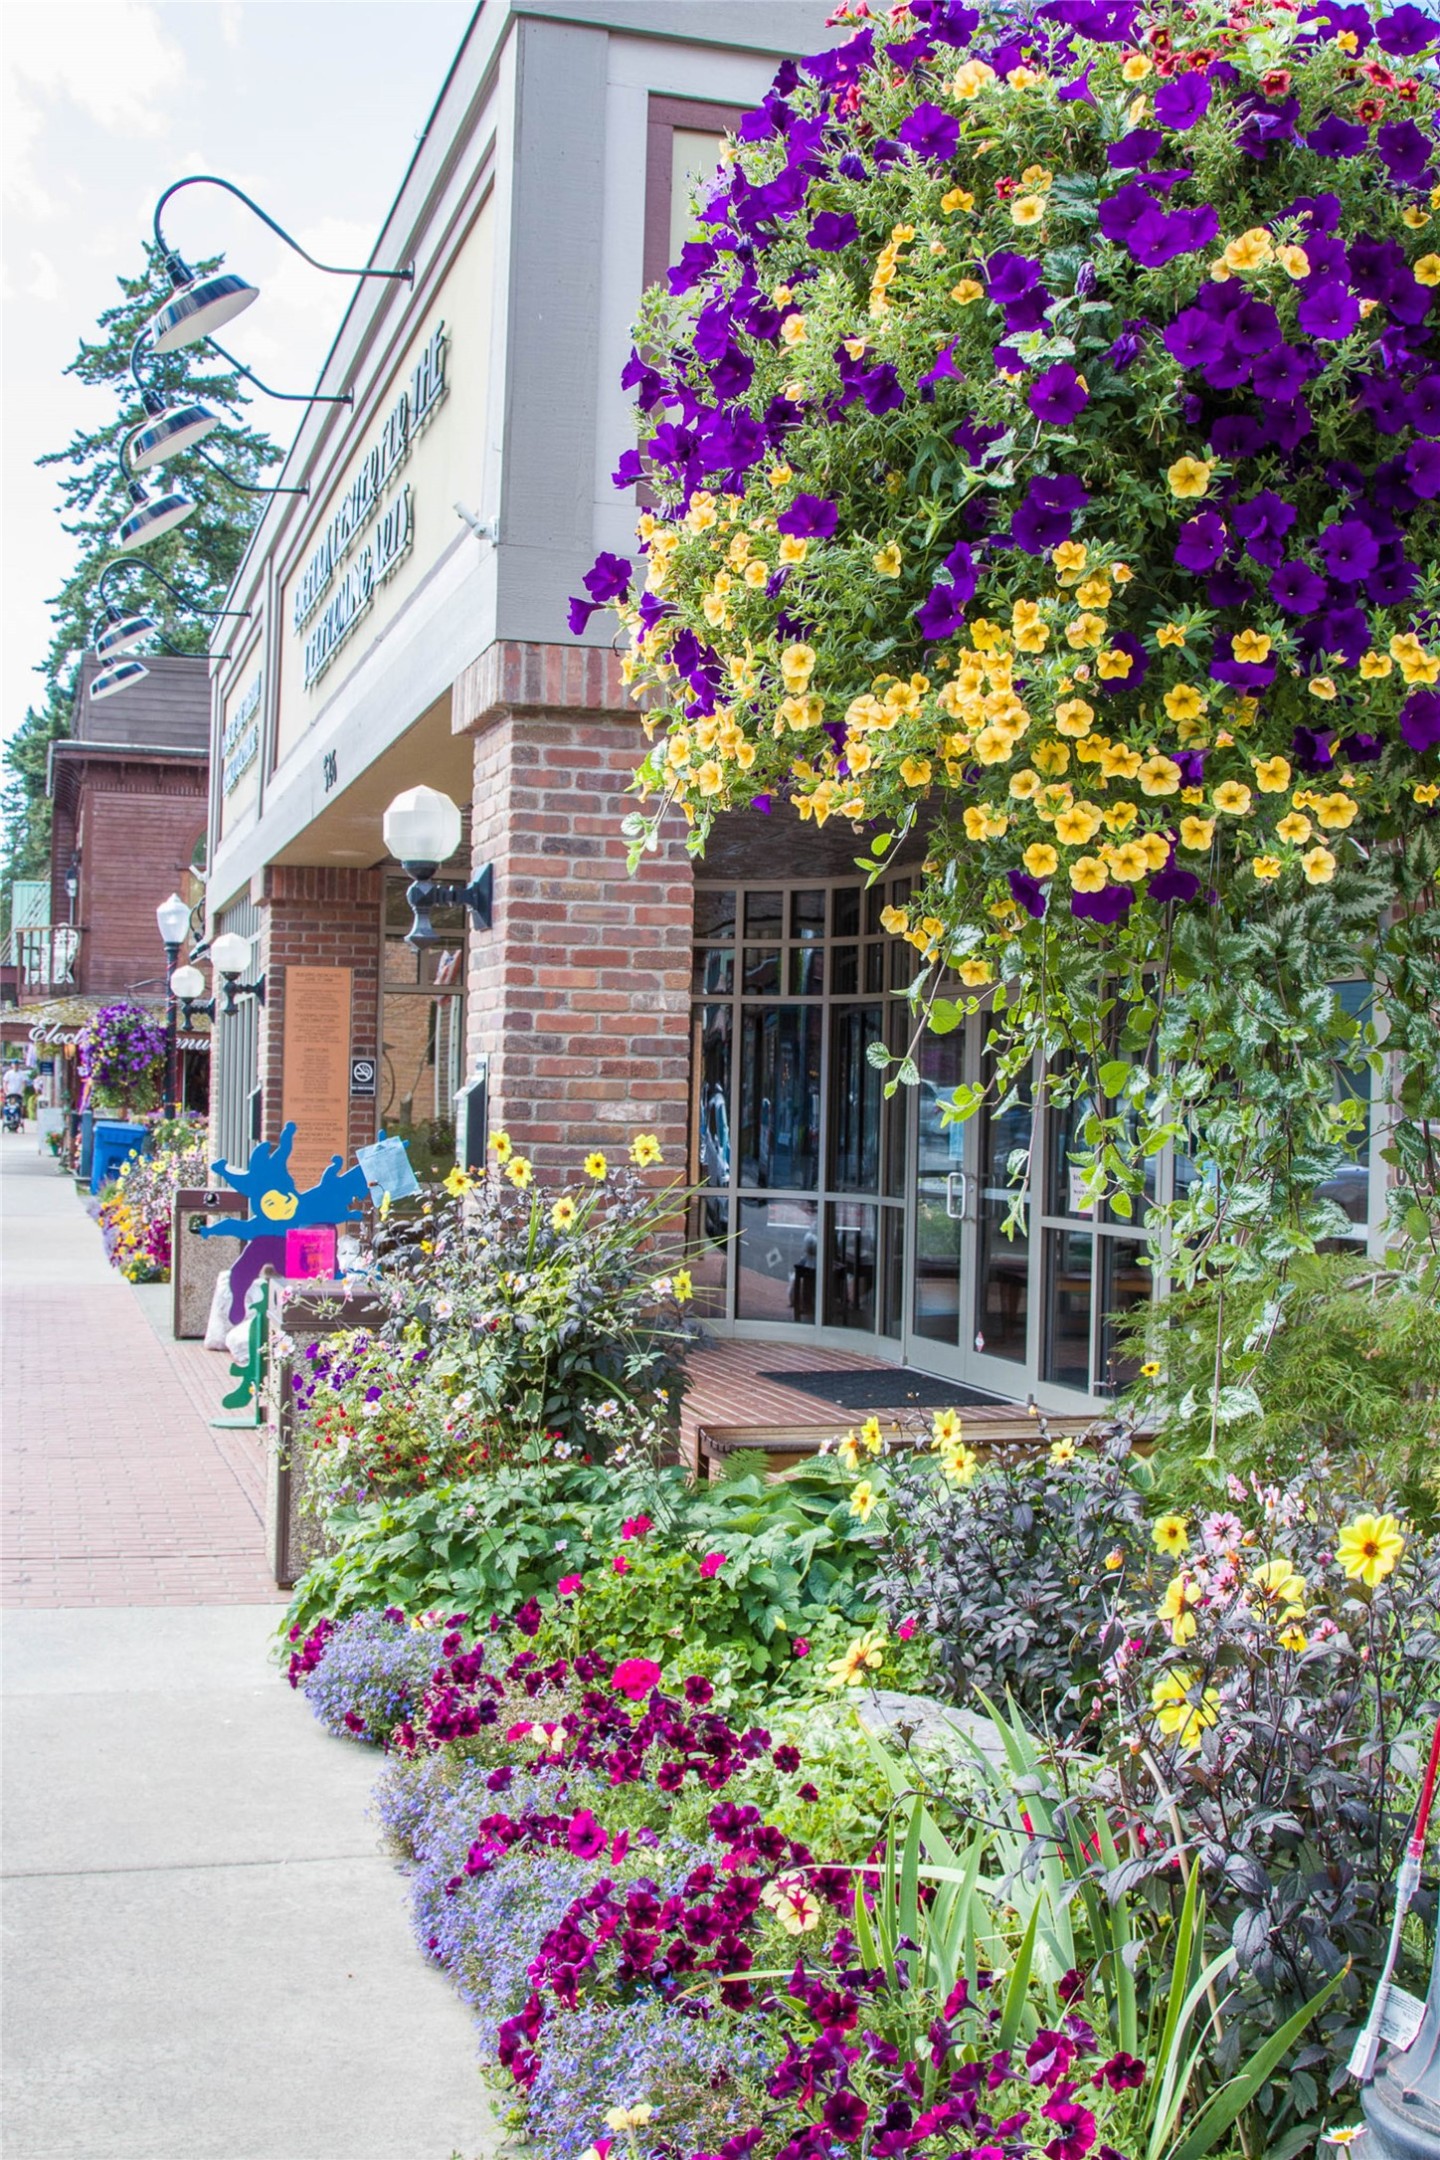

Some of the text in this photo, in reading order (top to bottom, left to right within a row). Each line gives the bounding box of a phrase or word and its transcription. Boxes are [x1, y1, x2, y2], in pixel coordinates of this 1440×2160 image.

[378, 391, 409, 484] FOR
[410, 319, 447, 438] THE
[372, 482, 411, 588] ARTS
[28, 1015, 88, 1045] Elect
